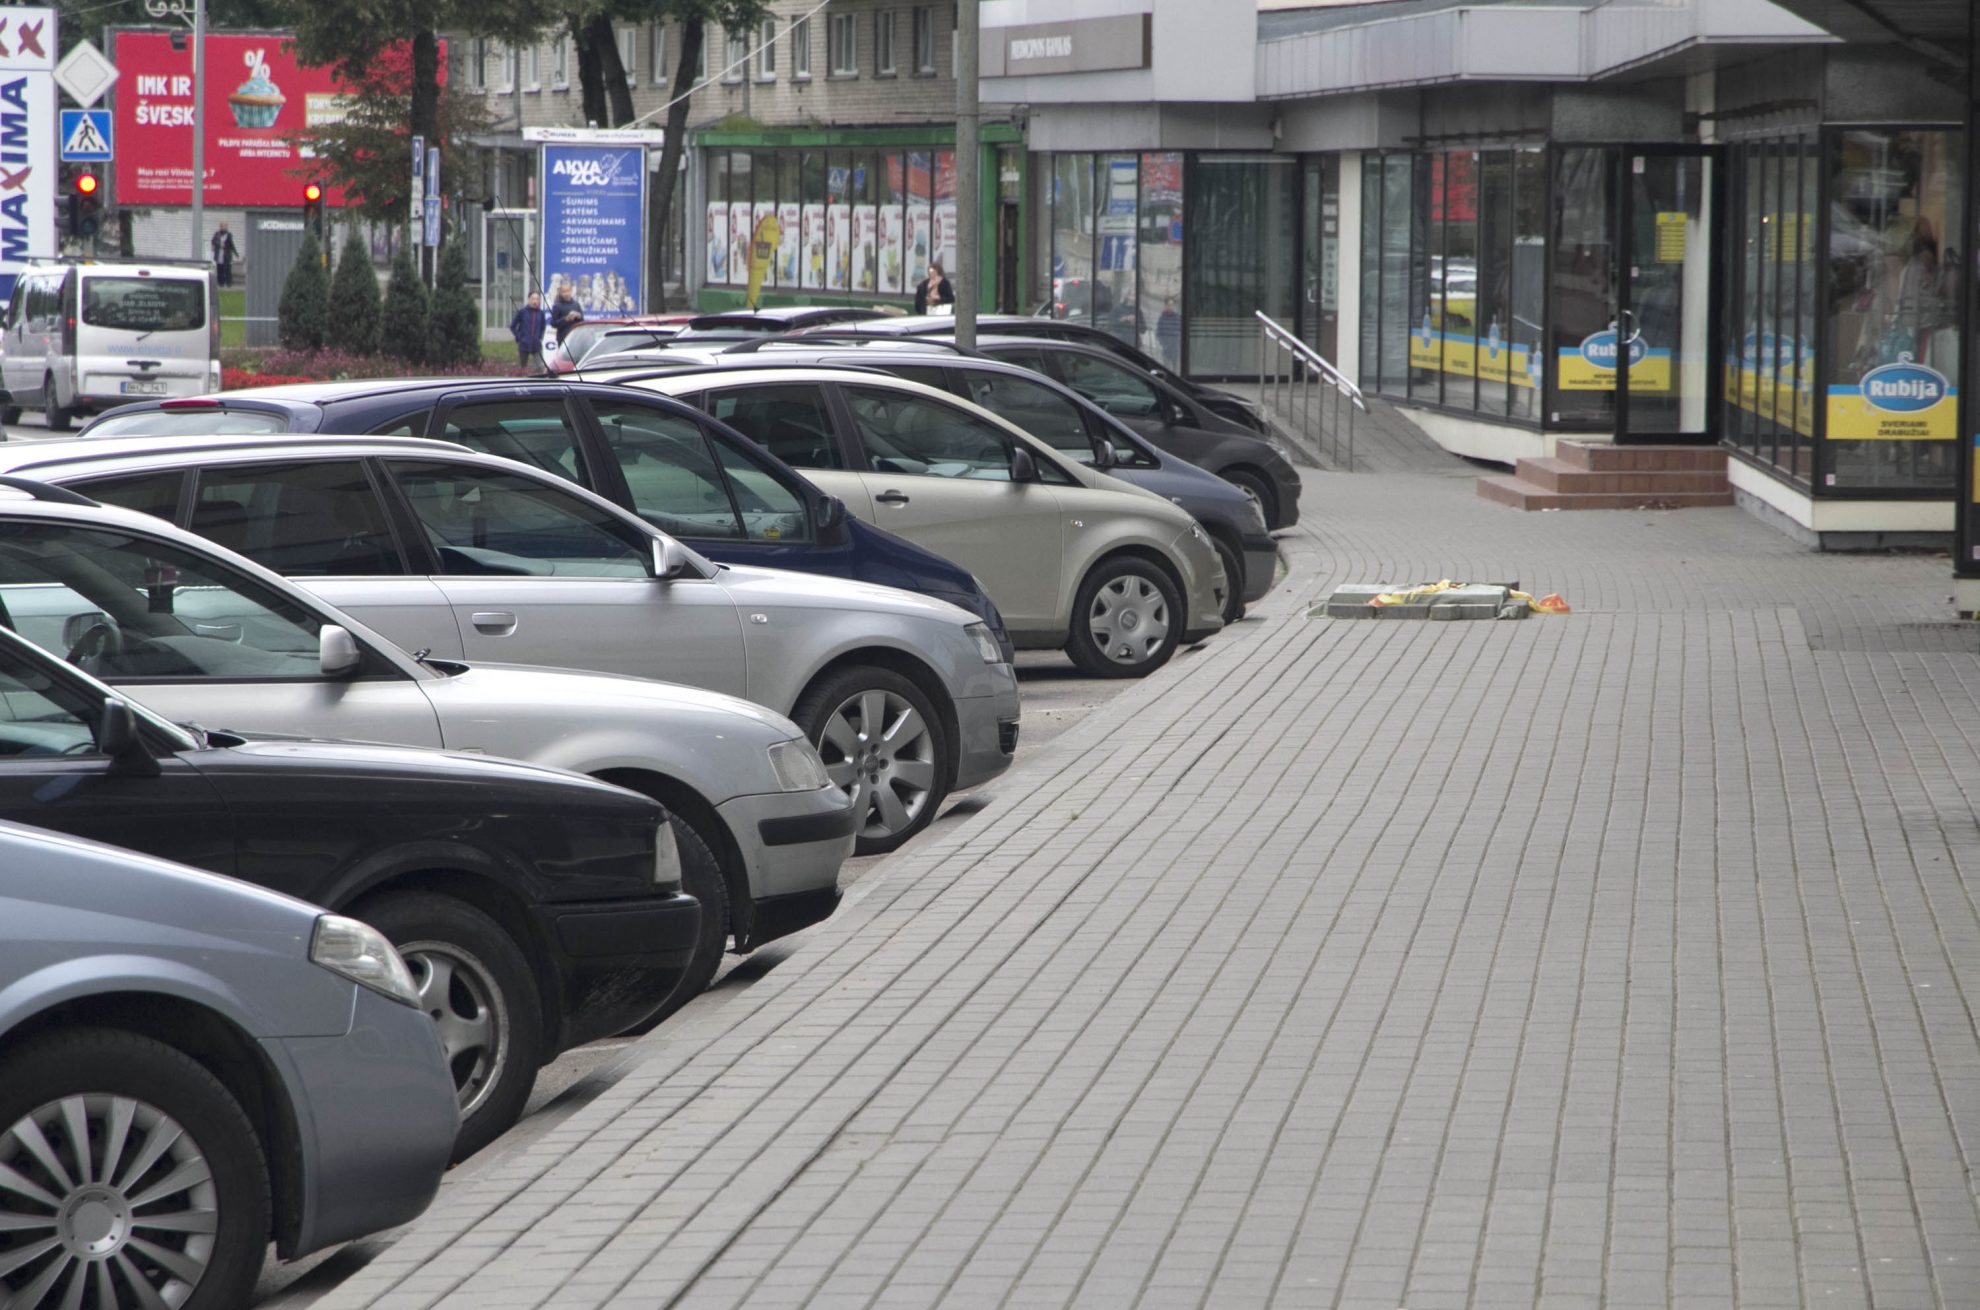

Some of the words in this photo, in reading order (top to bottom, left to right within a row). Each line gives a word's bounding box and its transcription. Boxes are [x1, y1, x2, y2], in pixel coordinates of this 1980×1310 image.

[137, 75, 168, 96] IMK
[172, 75, 192, 96] IR
[136, 99, 195, 127] ŠVĘSK
[0, 76, 33, 263] MAXIMA
[553, 160, 602, 176] AKVA
[570, 171, 610, 186] ZOO
[566, 197, 599, 206] ŠUNIMS
[566, 226, 598, 235] ŽUVIMS
[1588, 343, 1640, 357] Ruba
[1870, 380, 1938, 400] Rubija
